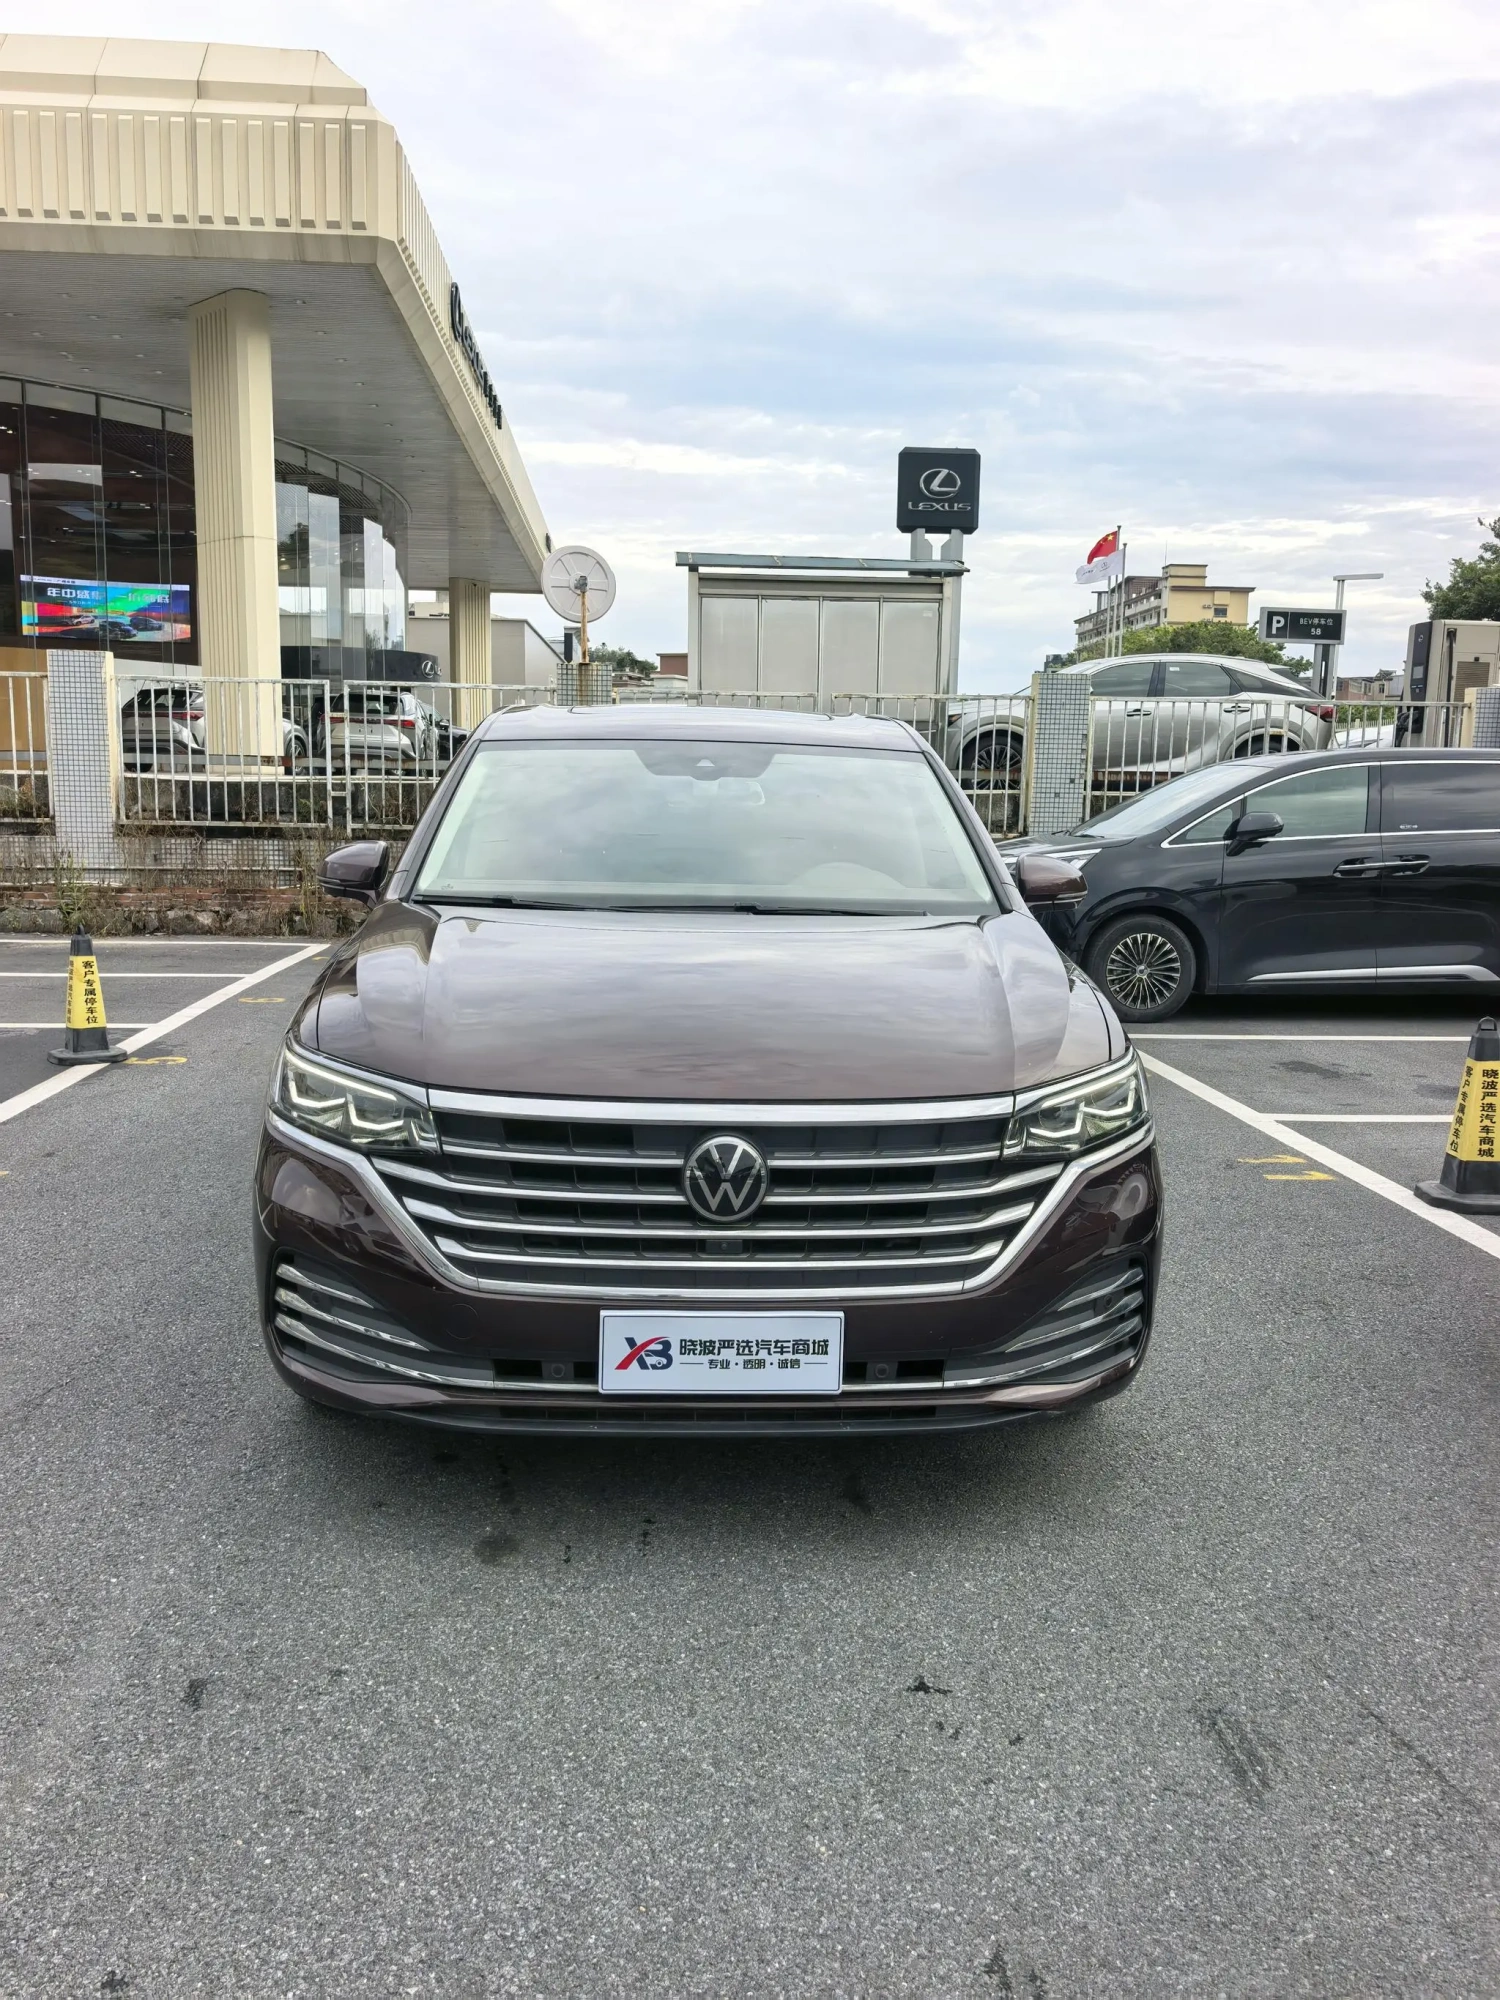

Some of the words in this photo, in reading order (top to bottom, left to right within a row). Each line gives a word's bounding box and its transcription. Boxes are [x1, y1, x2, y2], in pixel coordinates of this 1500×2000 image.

[907, 501, 971, 511] LEXUS
[1271, 615, 1285, 635] P
[1310, 627, 1322, 636] 58
[82, 960, 98, 1025] 客户专属停车位
[1449, 1065, 1474, 1153] 客户专属停车位
[1477, 1068, 1500, 1158] 晓波严选汽车商城
[679, 1339, 829, 1356] 晓波严选汽车商城
